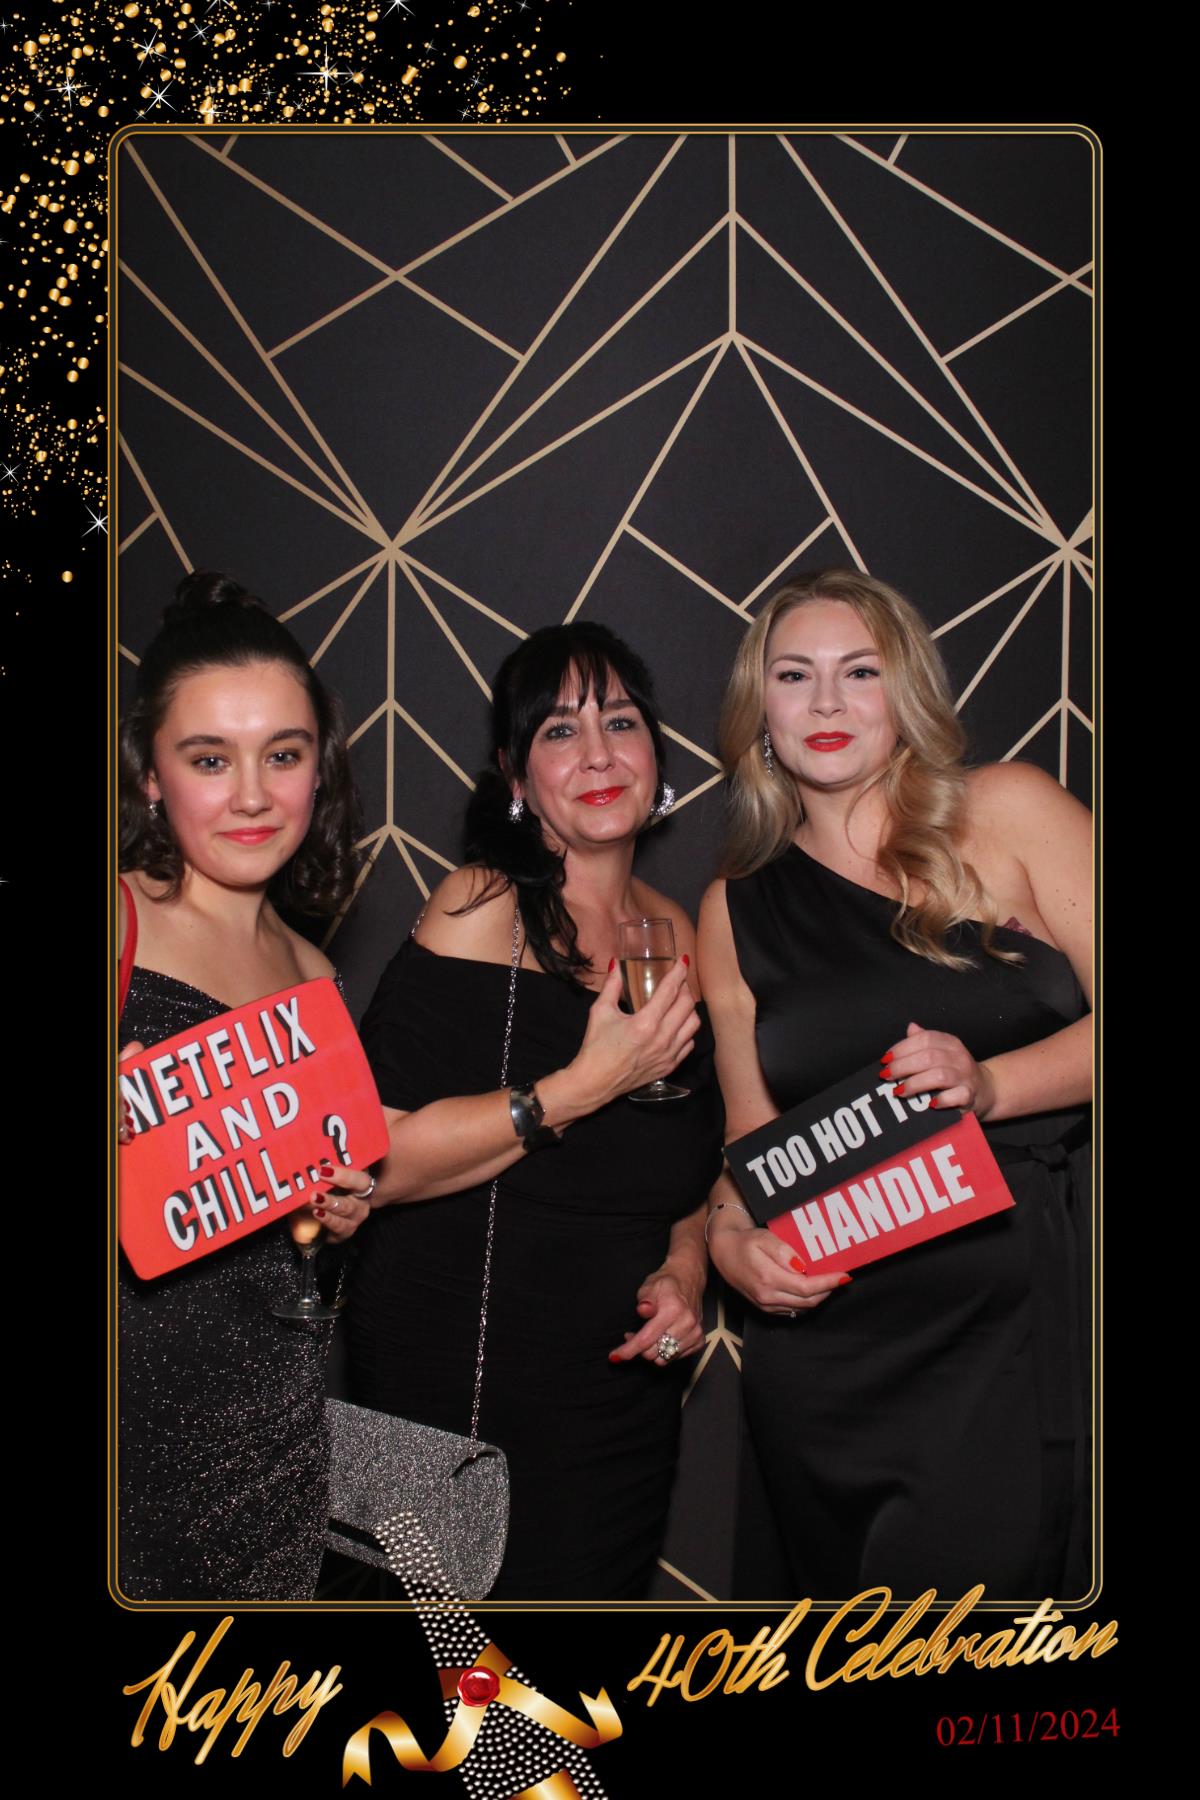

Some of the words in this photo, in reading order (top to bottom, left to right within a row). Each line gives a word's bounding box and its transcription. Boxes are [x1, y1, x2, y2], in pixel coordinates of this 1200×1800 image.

[119, 997, 316, 1134] NETFLIX
[163, 1114, 352, 1251] CHILL..?
[186, 1082, 300, 1172] AND
[746, 1134, 817, 1198] TOO
[810, 1094, 883, 1164] HOT
[791, 1143, 975, 1262] HANDLE
